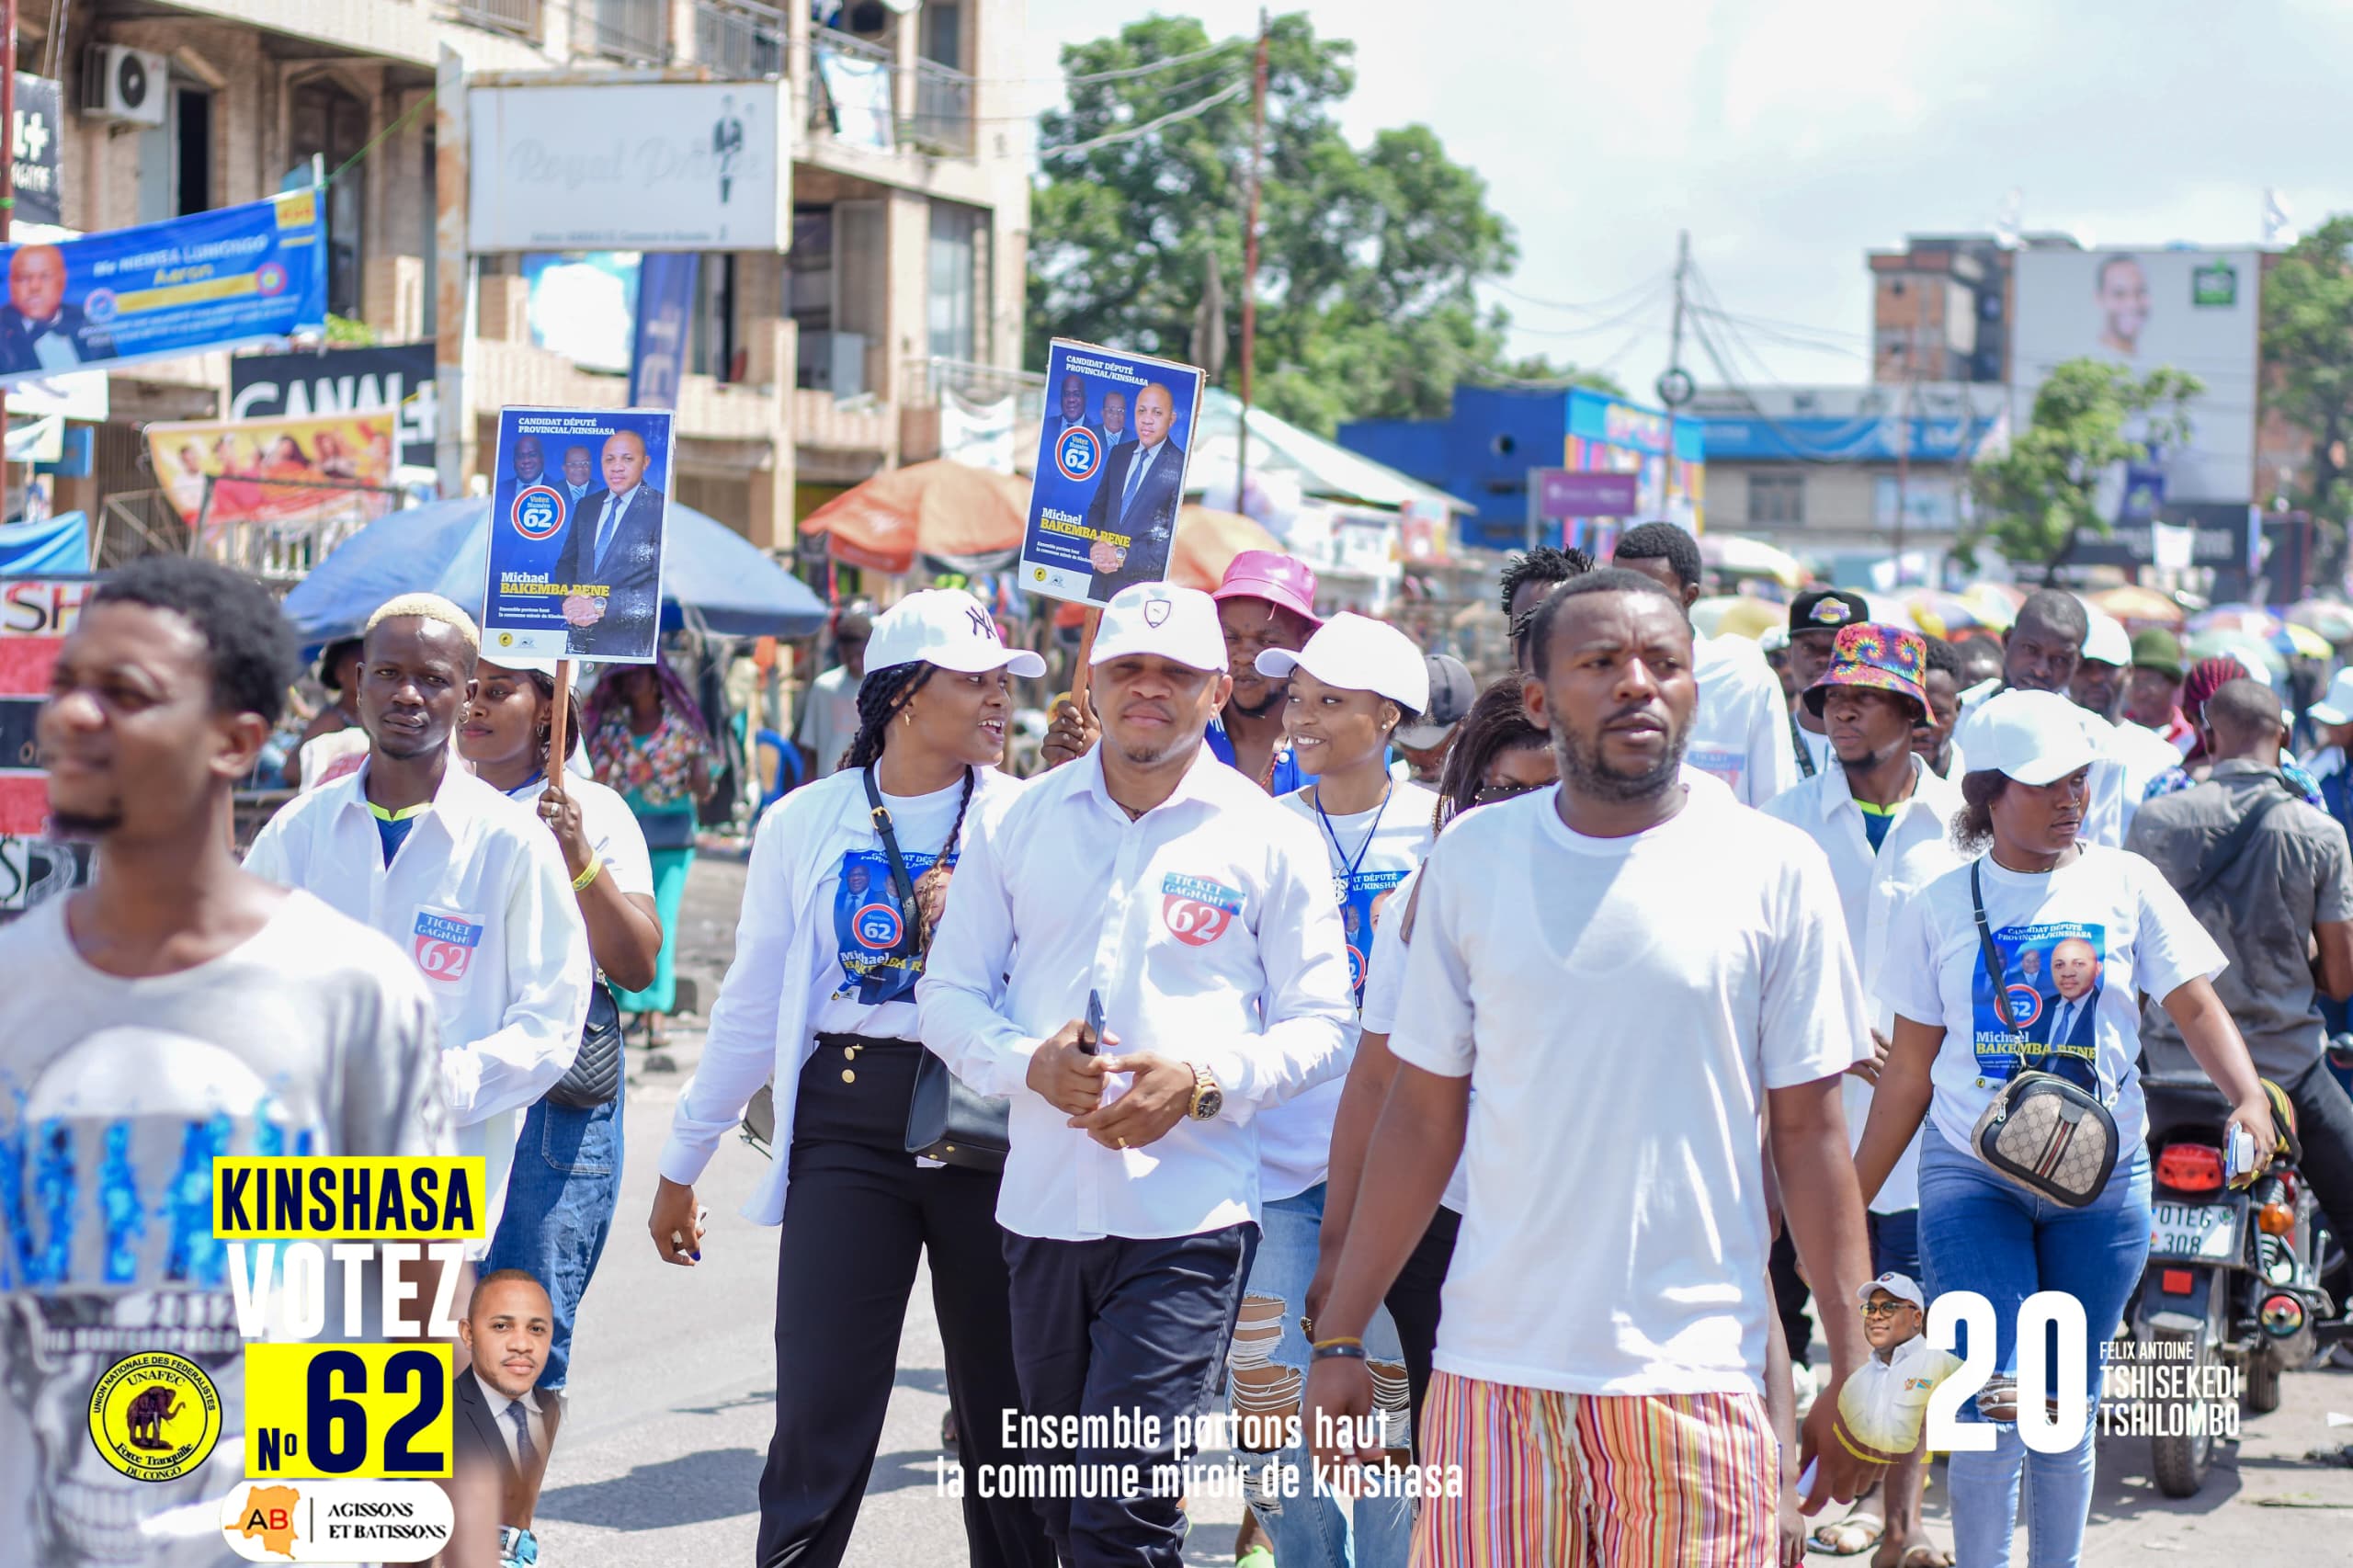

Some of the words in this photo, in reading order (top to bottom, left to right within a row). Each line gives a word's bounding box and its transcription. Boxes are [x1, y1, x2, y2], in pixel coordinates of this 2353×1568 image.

[1066, 355, 1104, 369] CANDIDAT
[1105, 362, 1134, 375] DÉPUTÉ
[1066, 363, 1149, 386] PROVINCIAL/KINSHASA
[518, 417, 562, 426] CANDIDAT
[563, 417, 597, 426] DÉPUTÉ
[518, 426, 615, 435] PROVINCIAL/KINSHASA
[1065, 448, 1090, 471] 62
[524, 508, 552, 528] 62
[1041, 507, 1082, 525] Michael
[1040, 517, 1097, 540] BAKEMBA
[501, 572, 549, 583] Michael
[500, 583, 569, 596] BAKEMBA
[1176, 875, 1222, 894] TICKET
[1363, 872, 1397, 882] DÉPUTÉ
[1165, 883, 1224, 906] GAGNANT
[426, 915, 471, 936] TICKET
[1166, 899, 1221, 941] 62
[864, 922, 891, 940] 62
[420, 940, 466, 977] 62
[2162, 1233, 2201, 1256] 308
